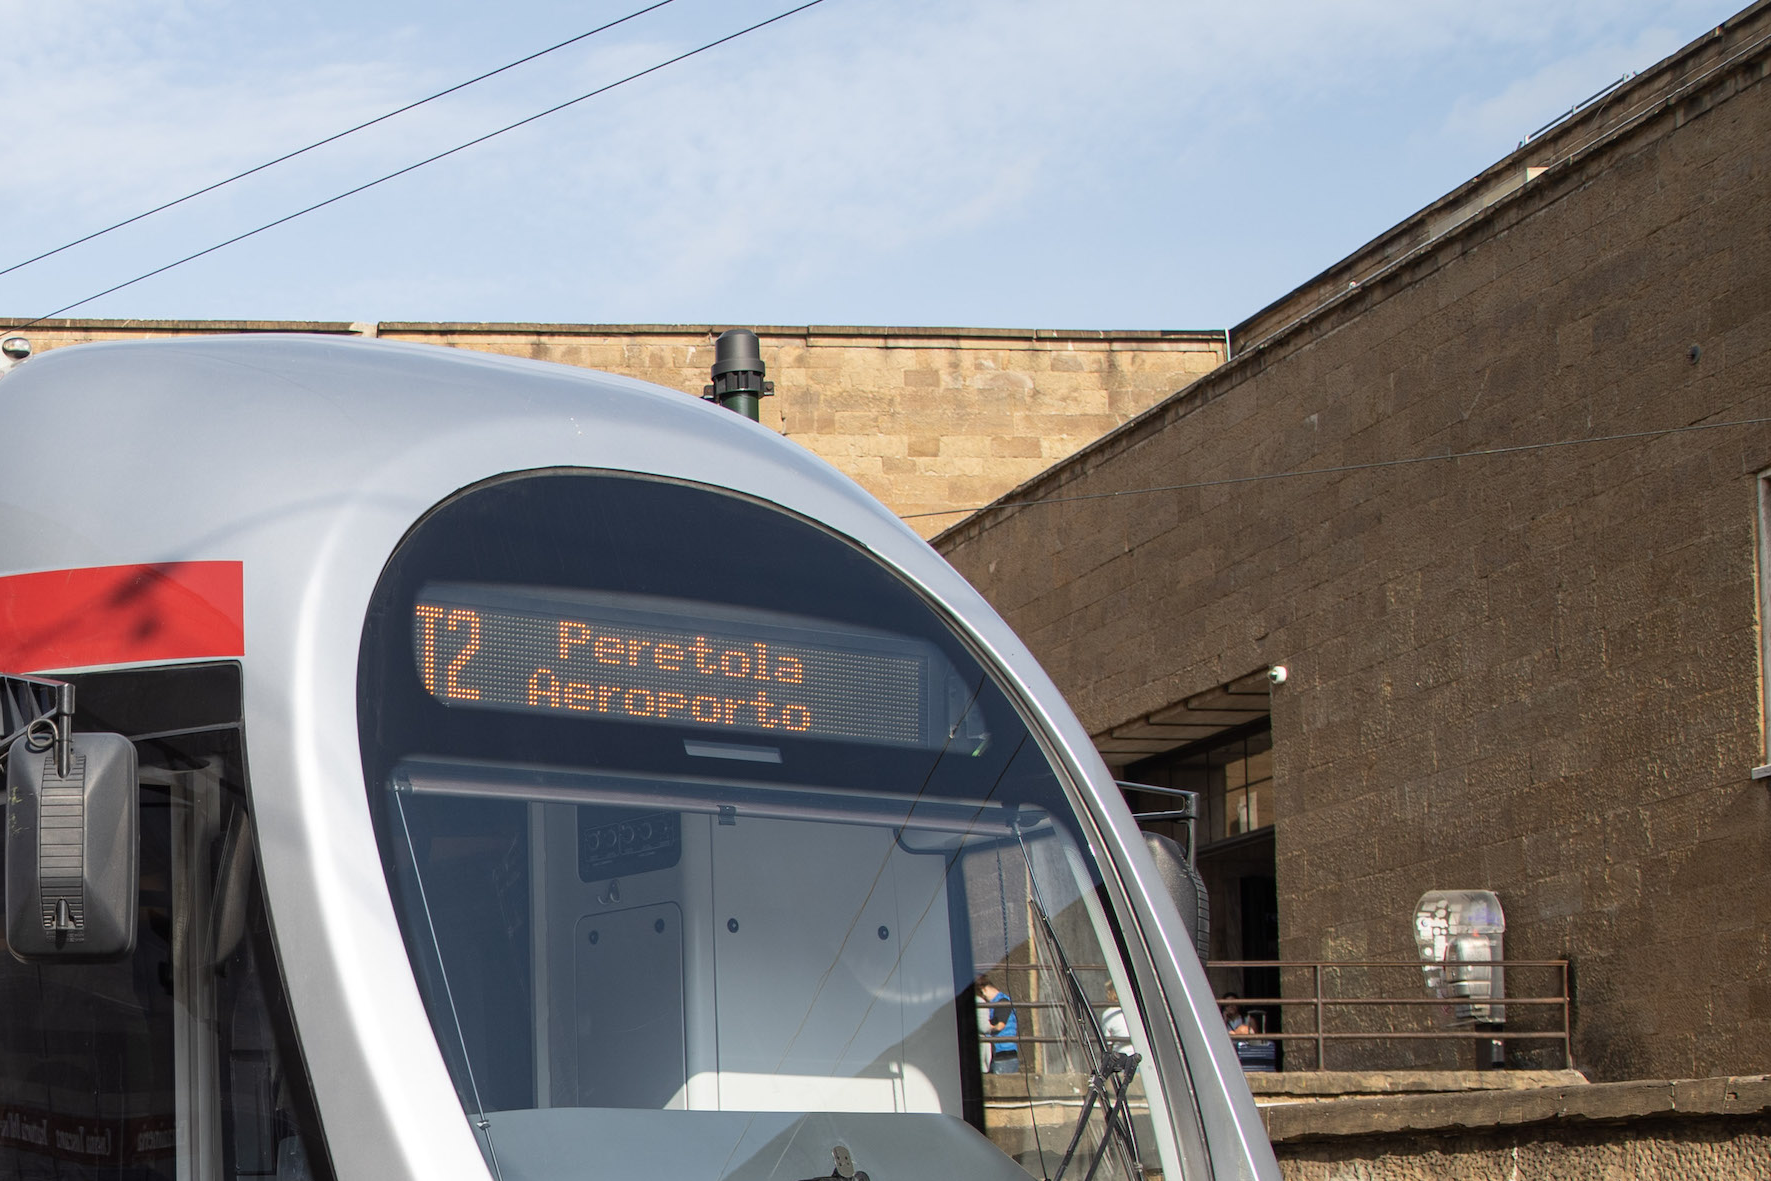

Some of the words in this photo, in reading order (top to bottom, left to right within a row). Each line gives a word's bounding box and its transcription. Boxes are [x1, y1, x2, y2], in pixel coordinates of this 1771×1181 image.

[416, 604, 481, 700] T2
[559, 621, 804, 684] Peretola
[529, 668, 811, 732] Aeroporto
